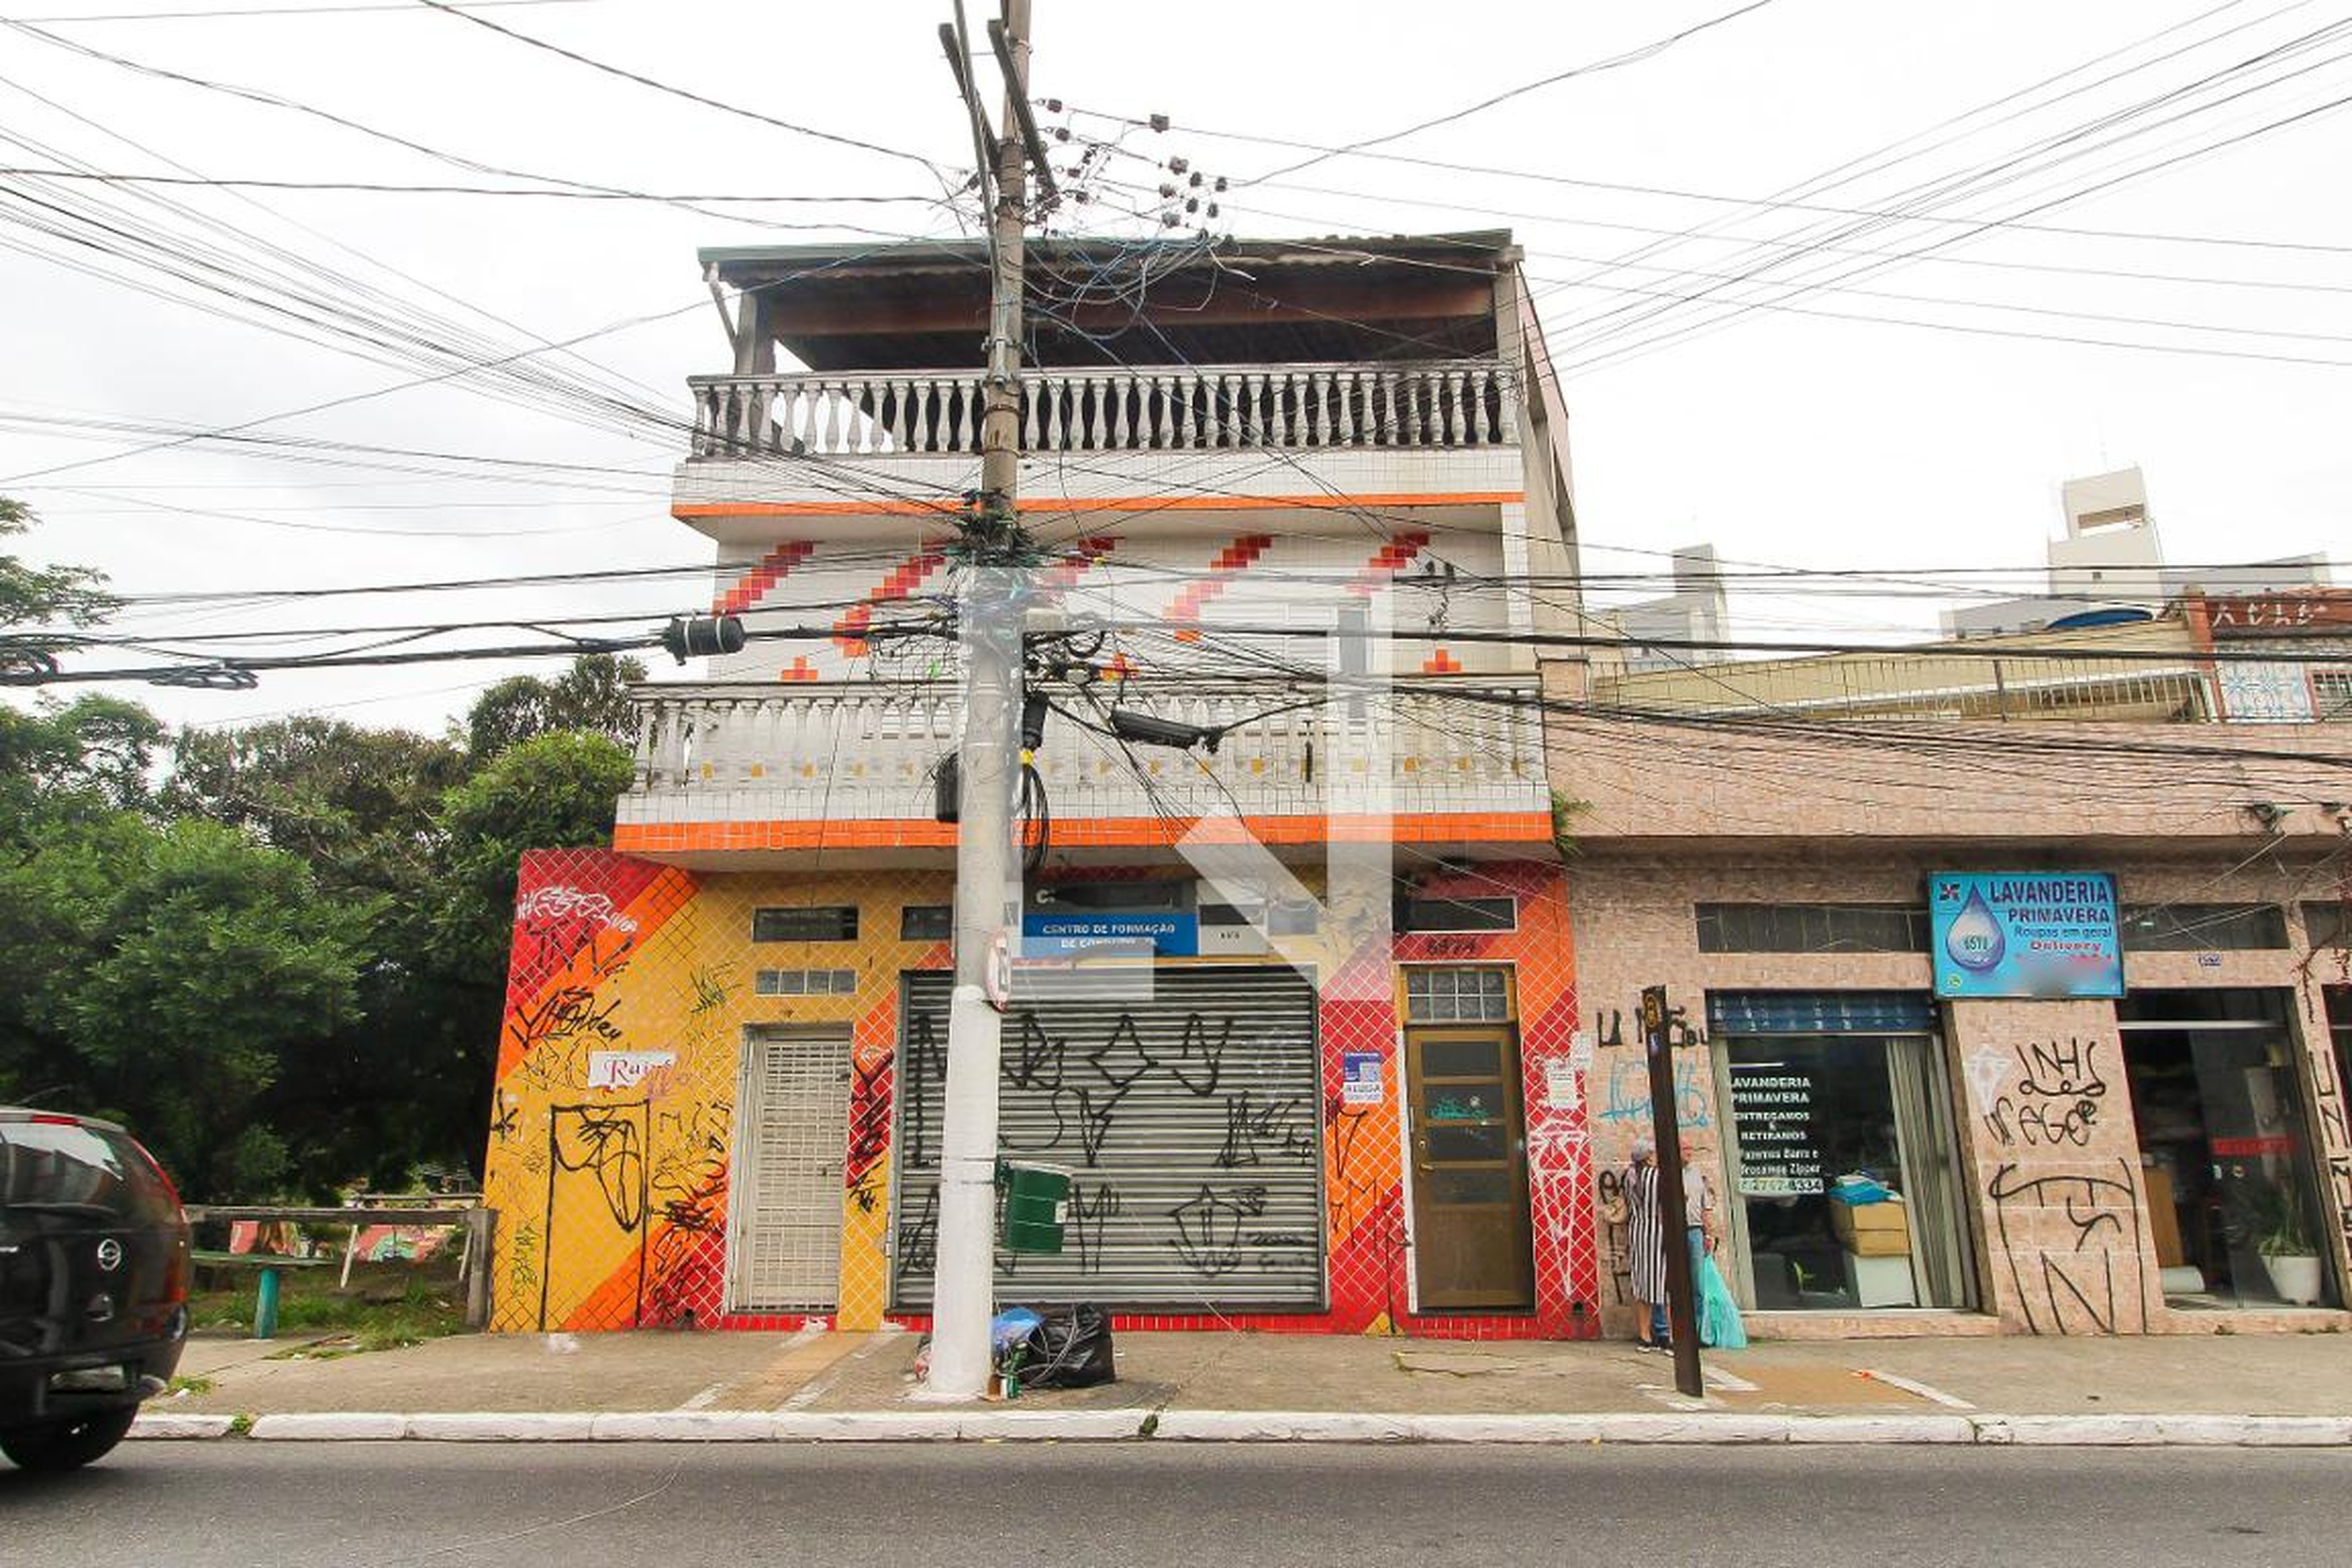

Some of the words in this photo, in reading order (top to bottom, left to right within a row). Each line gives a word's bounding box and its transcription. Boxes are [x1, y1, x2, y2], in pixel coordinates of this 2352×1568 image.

[1990, 880, 2109, 903] LAVANDERIA
[2008, 907, 2110, 923] PRIMAVERA
[1042, 924, 1090, 935] CENTRO
[1093, 924, 1108, 935] DE
[1111, 922, 1176, 936] FORMAÇÃO
[2015, 925, 2059, 938] Roupas
[2061, 927, 2081, 938] em
[2082, 925, 2113, 940] geral
[1732, 1077, 1811, 1088] AVANDERIA
